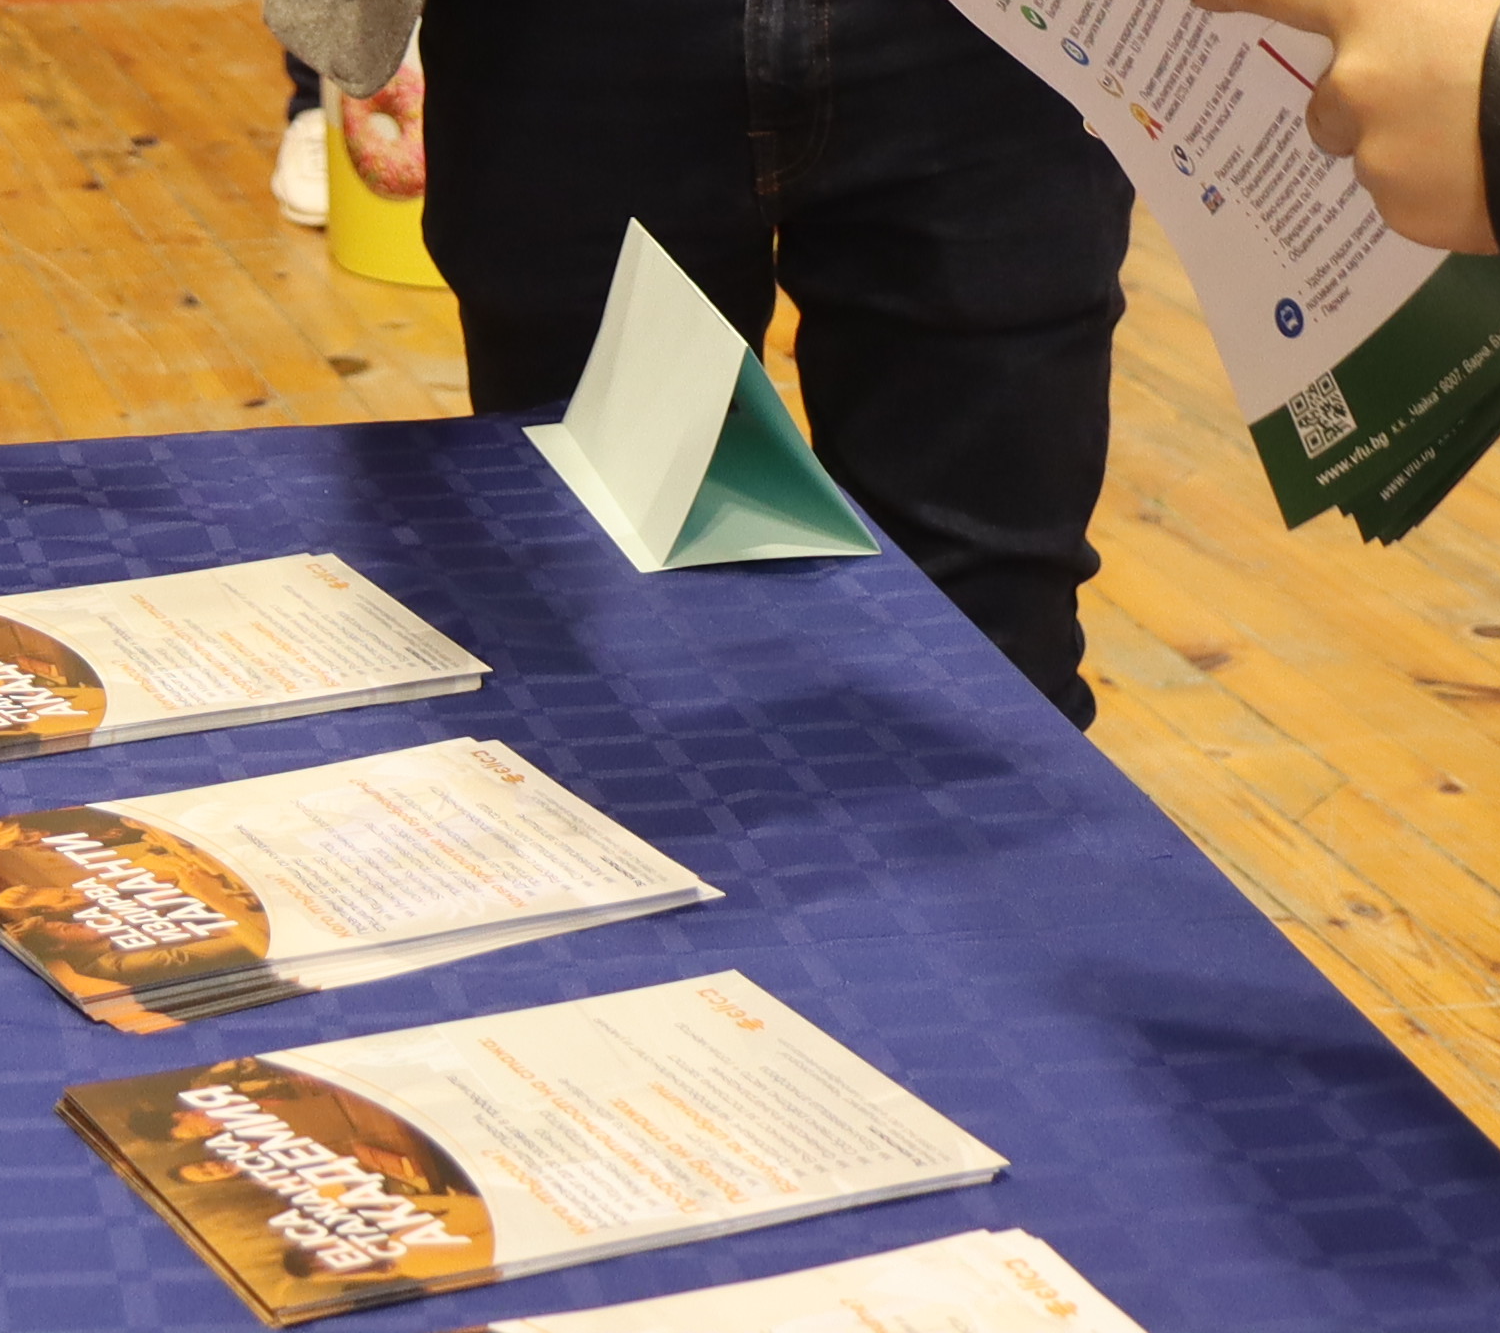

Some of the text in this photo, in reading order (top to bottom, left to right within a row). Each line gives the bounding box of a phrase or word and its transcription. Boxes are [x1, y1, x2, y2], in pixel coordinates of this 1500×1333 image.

[465, 750, 512, 773] elica
[40, 831, 238, 936] ТАЛАНТИ
[71, 877, 190, 941] ИЗДИРВА
[70, 906, 156, 948] ELICA
[691, 989, 748, 1017] elica
[176, 1083, 472, 1243] АКАДЕМИЯ
[205, 1131, 406, 1257] СТАЖАНТСКА
[267, 1208, 372, 1269] ELICA
